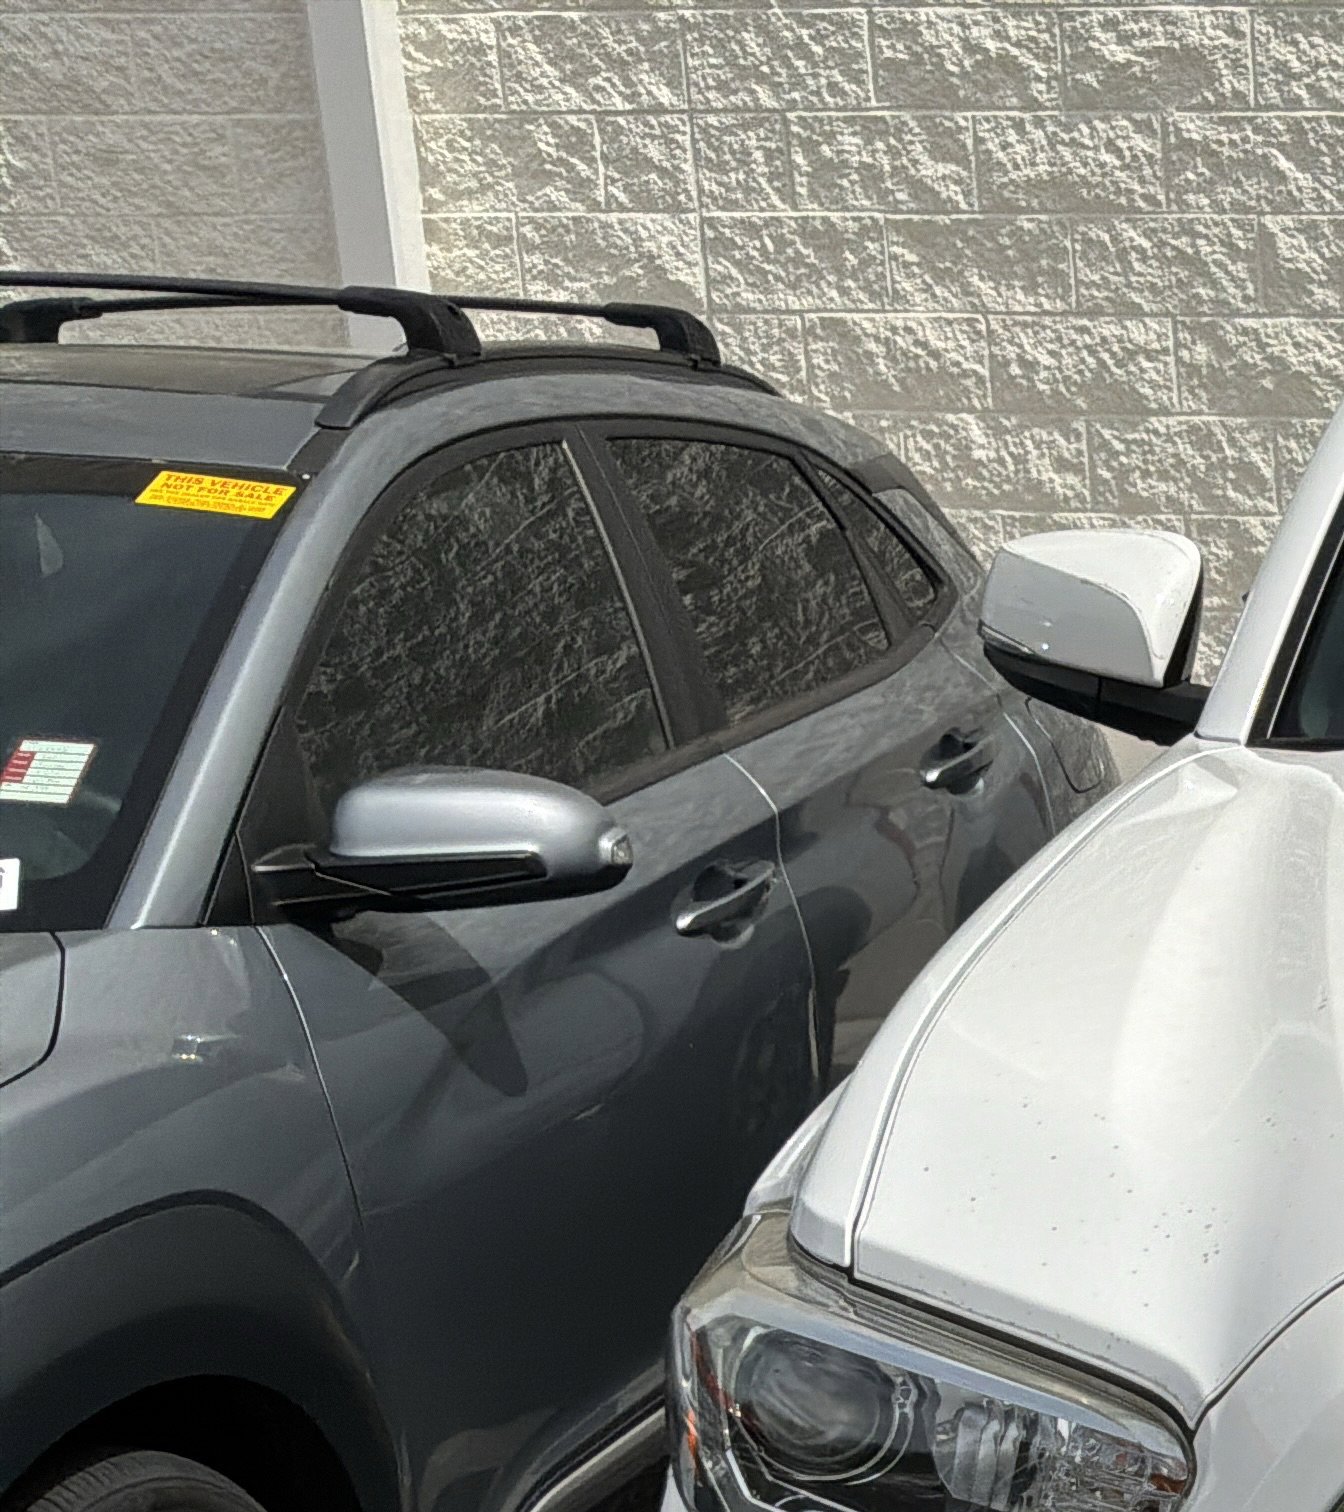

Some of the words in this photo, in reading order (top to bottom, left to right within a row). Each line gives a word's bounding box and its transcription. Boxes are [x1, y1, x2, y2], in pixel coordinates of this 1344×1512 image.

[160, 482, 193, 492] NOT
[197, 485, 229, 496] FOR
[164, 474, 206, 485] THIS
[210, 479, 288, 496] VEHICLE
